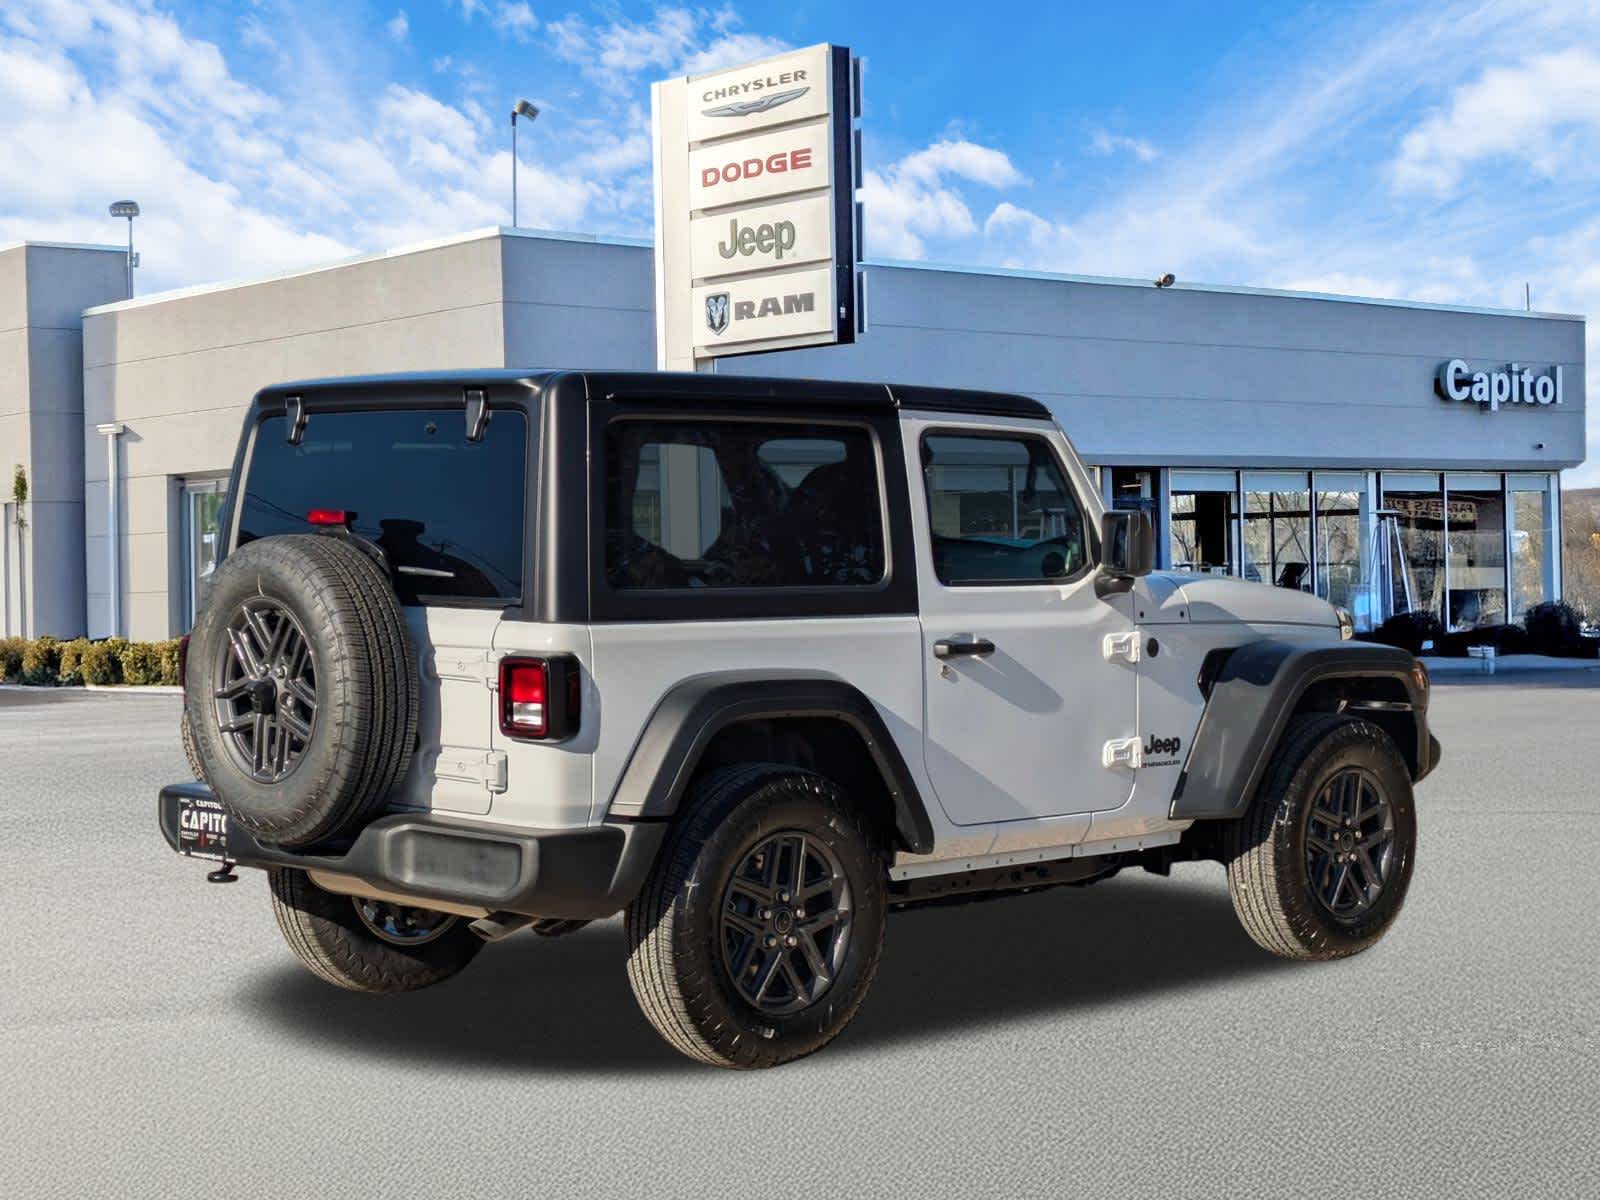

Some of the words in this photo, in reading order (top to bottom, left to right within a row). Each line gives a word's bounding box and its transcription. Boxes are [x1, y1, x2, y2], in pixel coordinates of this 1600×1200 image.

[702, 69, 808, 103] CHRYSLER
[702, 148, 813, 188] DODGE
[718, 218, 796, 260] Jeep
[734, 292, 815, 321] RAM
[1446, 358, 1563, 412] Capitol
[1143, 733, 1181, 756] Jeep
